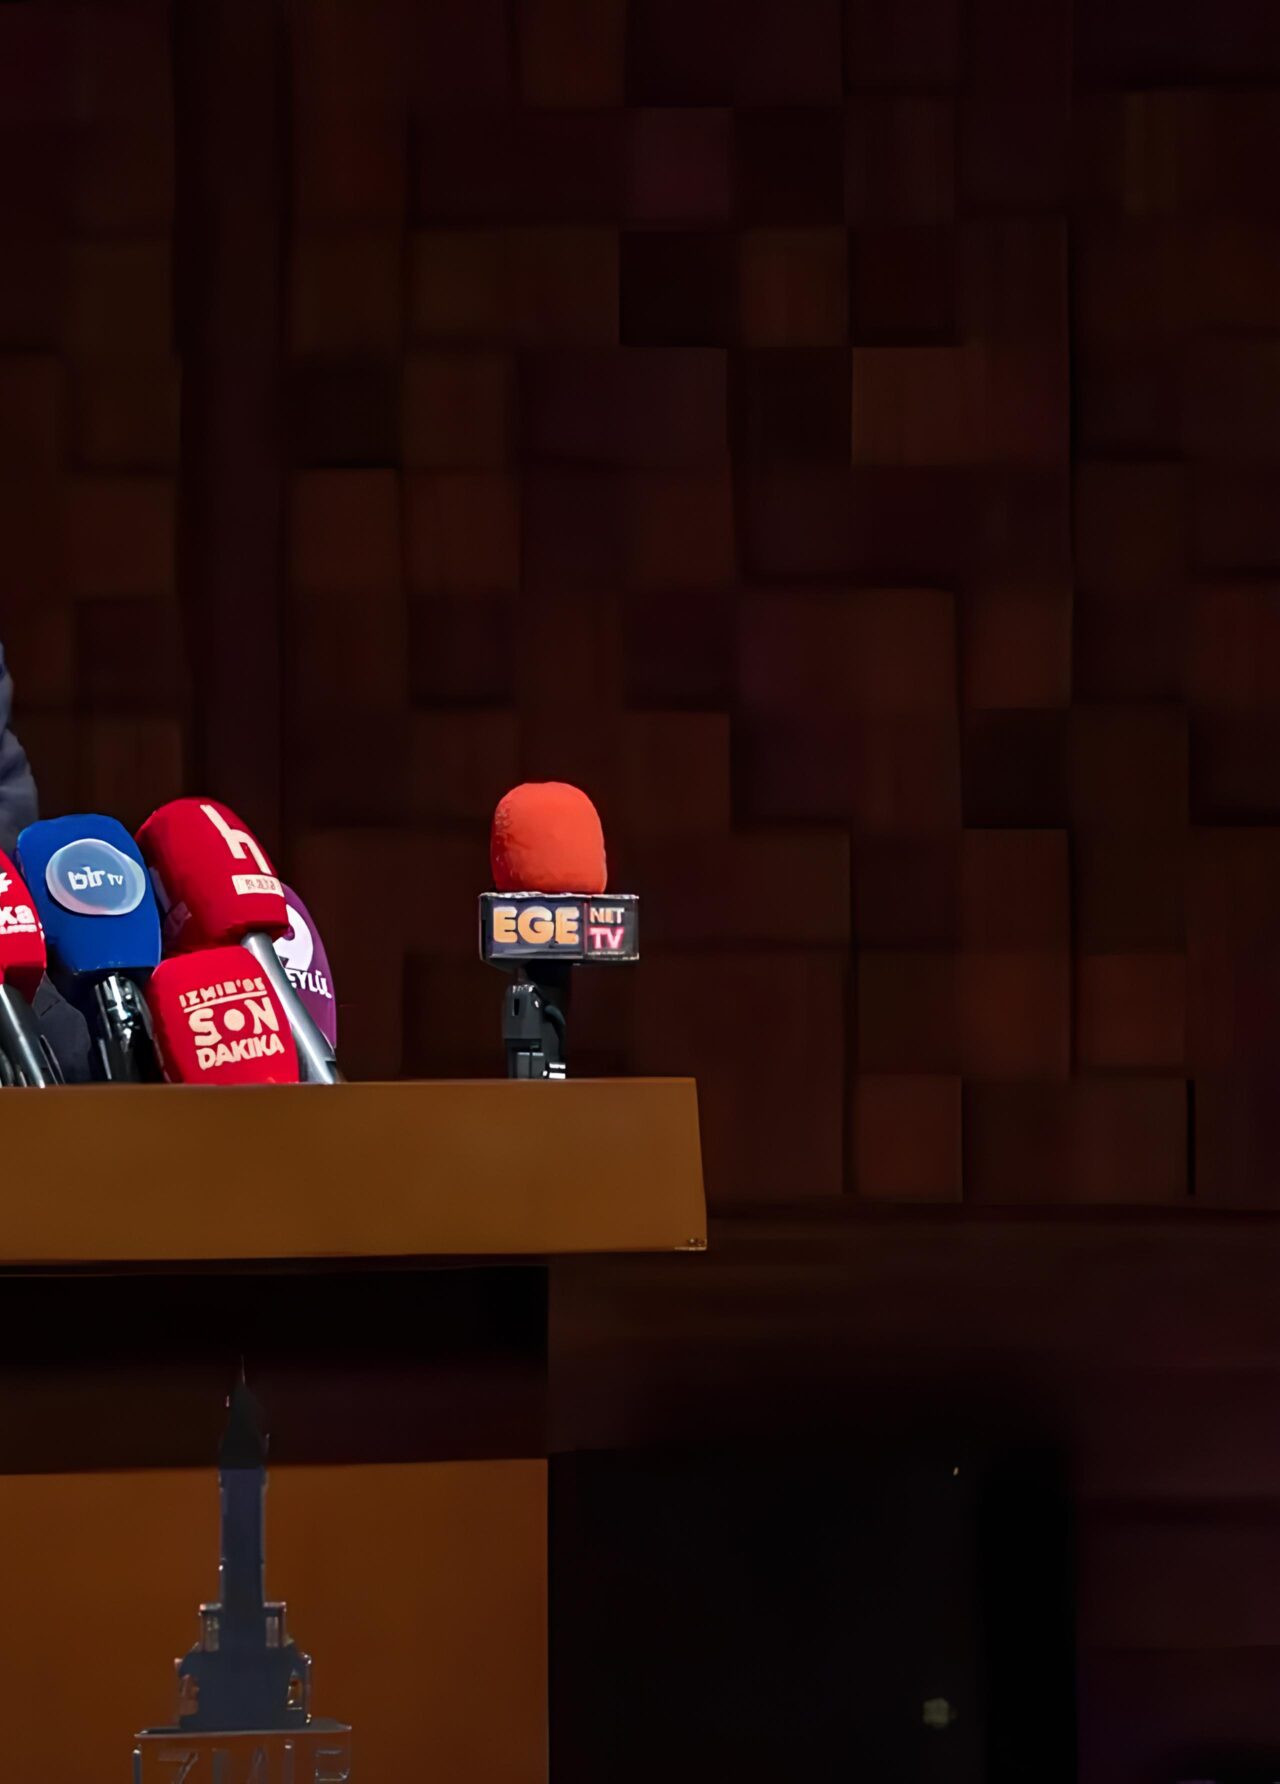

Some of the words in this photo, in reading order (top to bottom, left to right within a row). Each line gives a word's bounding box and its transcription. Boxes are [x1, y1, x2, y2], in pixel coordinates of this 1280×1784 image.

[493, 905, 580, 945] EGE
[589, 907, 625, 924] NET
[589, 926, 625, 950] TV
[188, 996, 280, 1047] SON
